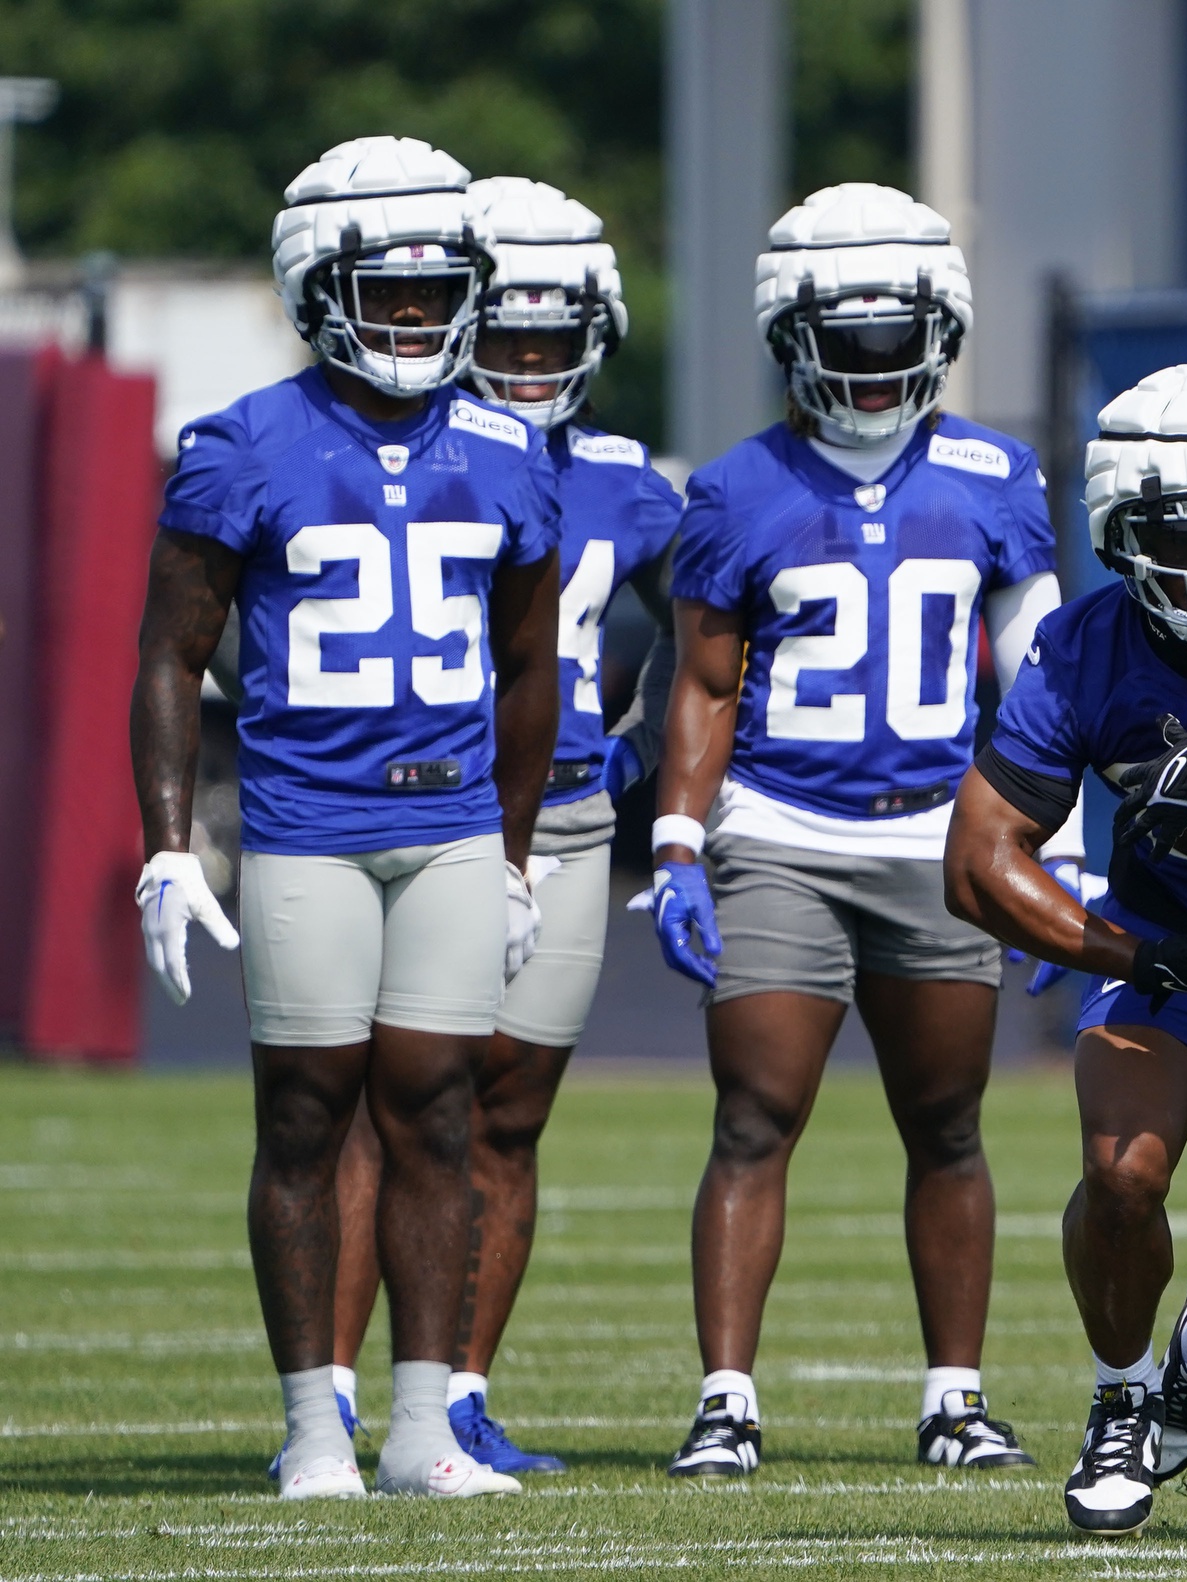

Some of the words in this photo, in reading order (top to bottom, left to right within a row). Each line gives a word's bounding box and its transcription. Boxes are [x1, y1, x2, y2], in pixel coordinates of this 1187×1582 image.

[455, 406, 521, 439] Quest
[570, 432, 637, 455] Quest
[936, 443, 1002, 466] Quest
[286, 522, 504, 707] 25
[765, 558, 982, 742] 20
